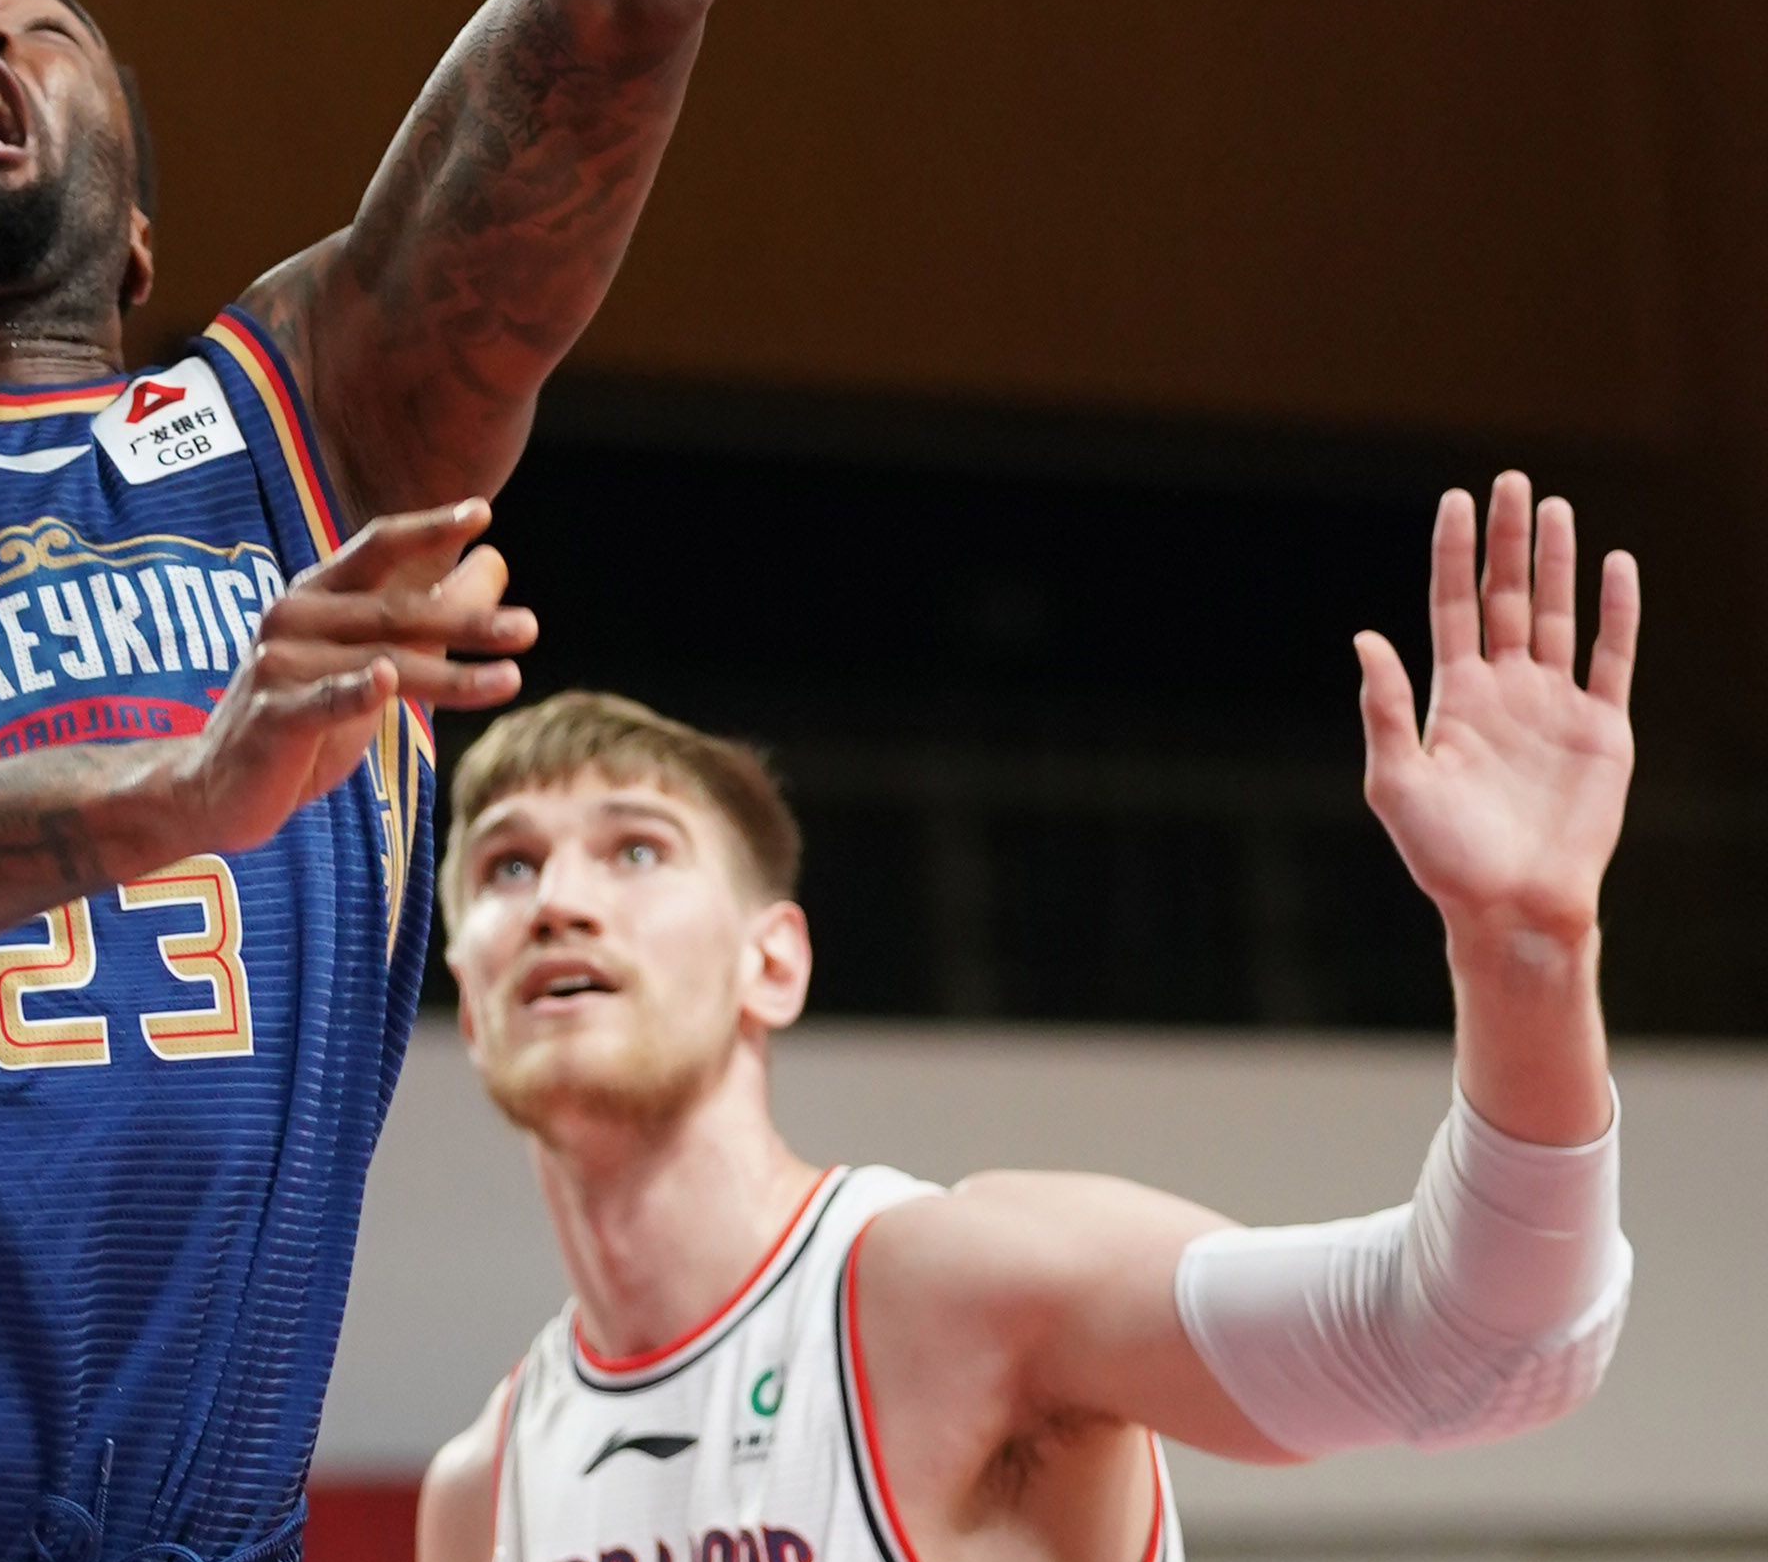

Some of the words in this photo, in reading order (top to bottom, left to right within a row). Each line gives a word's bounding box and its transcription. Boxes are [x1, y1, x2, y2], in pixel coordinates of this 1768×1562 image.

[129, 406, 218, 456] 广发银行
[157, 434, 213, 466] CGB
